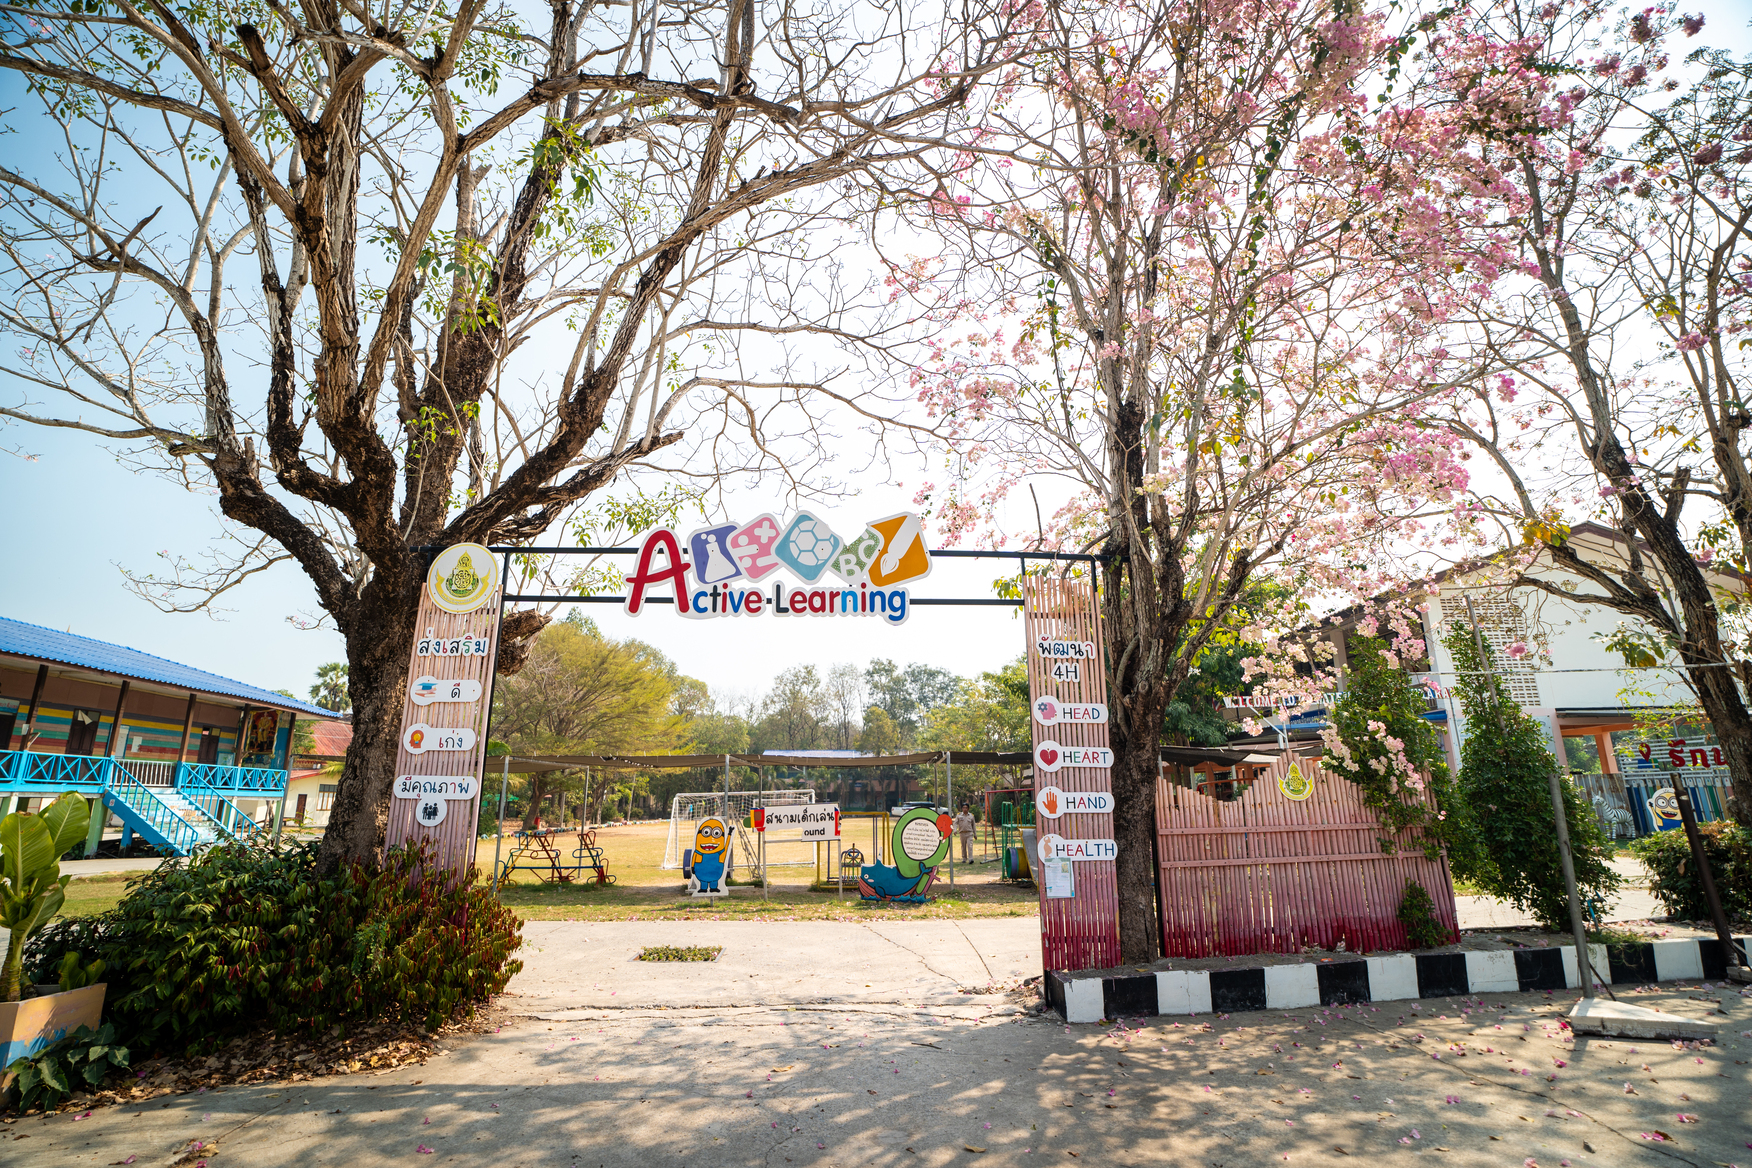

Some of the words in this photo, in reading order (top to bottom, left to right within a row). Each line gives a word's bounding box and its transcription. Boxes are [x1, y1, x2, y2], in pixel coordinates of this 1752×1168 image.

[625, 529, 763, 614] Active
[775, 582, 906, 622] Learning
[419, 629, 486, 654] ส่งเสริม
[1038, 636, 1094, 657] พัฒนา
[1054, 665, 1078, 680] 4H
[450, 682, 461, 699] ดี
[1223, 694, 1279, 709] WELCOME
[1063, 707, 1100, 720] HEAD
[438, 730, 463, 749] เก่ง
[1063, 750, 1109, 765] HEART
[401, 776, 470, 799] มีคุณภาพ
[1066, 795, 1107, 810] HAND
[765, 807, 835, 825] สนามเด็กเล่น
[1055, 842, 1115, 857] HEALTH
